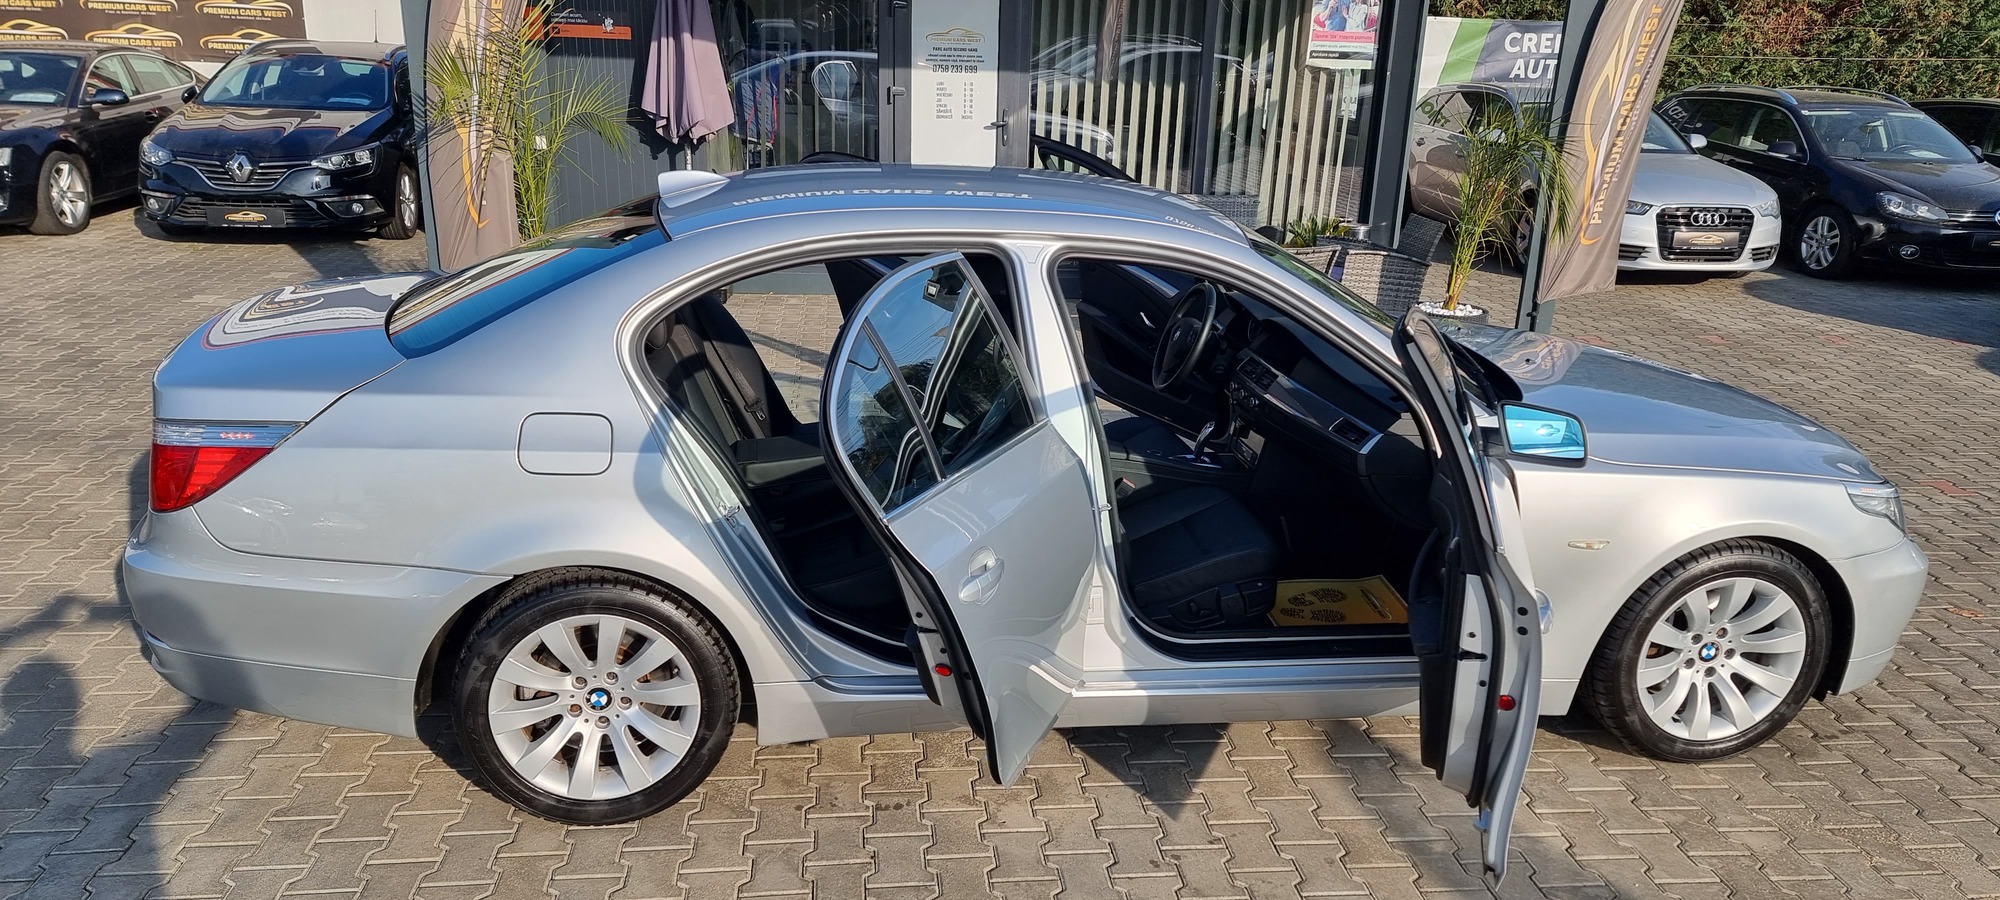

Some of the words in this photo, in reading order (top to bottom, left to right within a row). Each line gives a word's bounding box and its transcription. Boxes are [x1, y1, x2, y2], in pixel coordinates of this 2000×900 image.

[34, 0, 56, 8] WEST
[88, 2, 124, 10] PREMIUM
[203, 7, 239, 15] PREMIUM
[263, 10, 287, 18] WEST
[93, 37, 129, 46] PREMIUM
[153, 40, 177, 48] WEST
[208, 42, 244, 51] PREMIUM
[932, 64, 949, 73] 0758
[951, 65, 963, 73] 233
[964, 65, 978, 74] 699
[1590, 135, 1625, 224] PREMIUM
[1635, 4, 1663, 68] WEST
